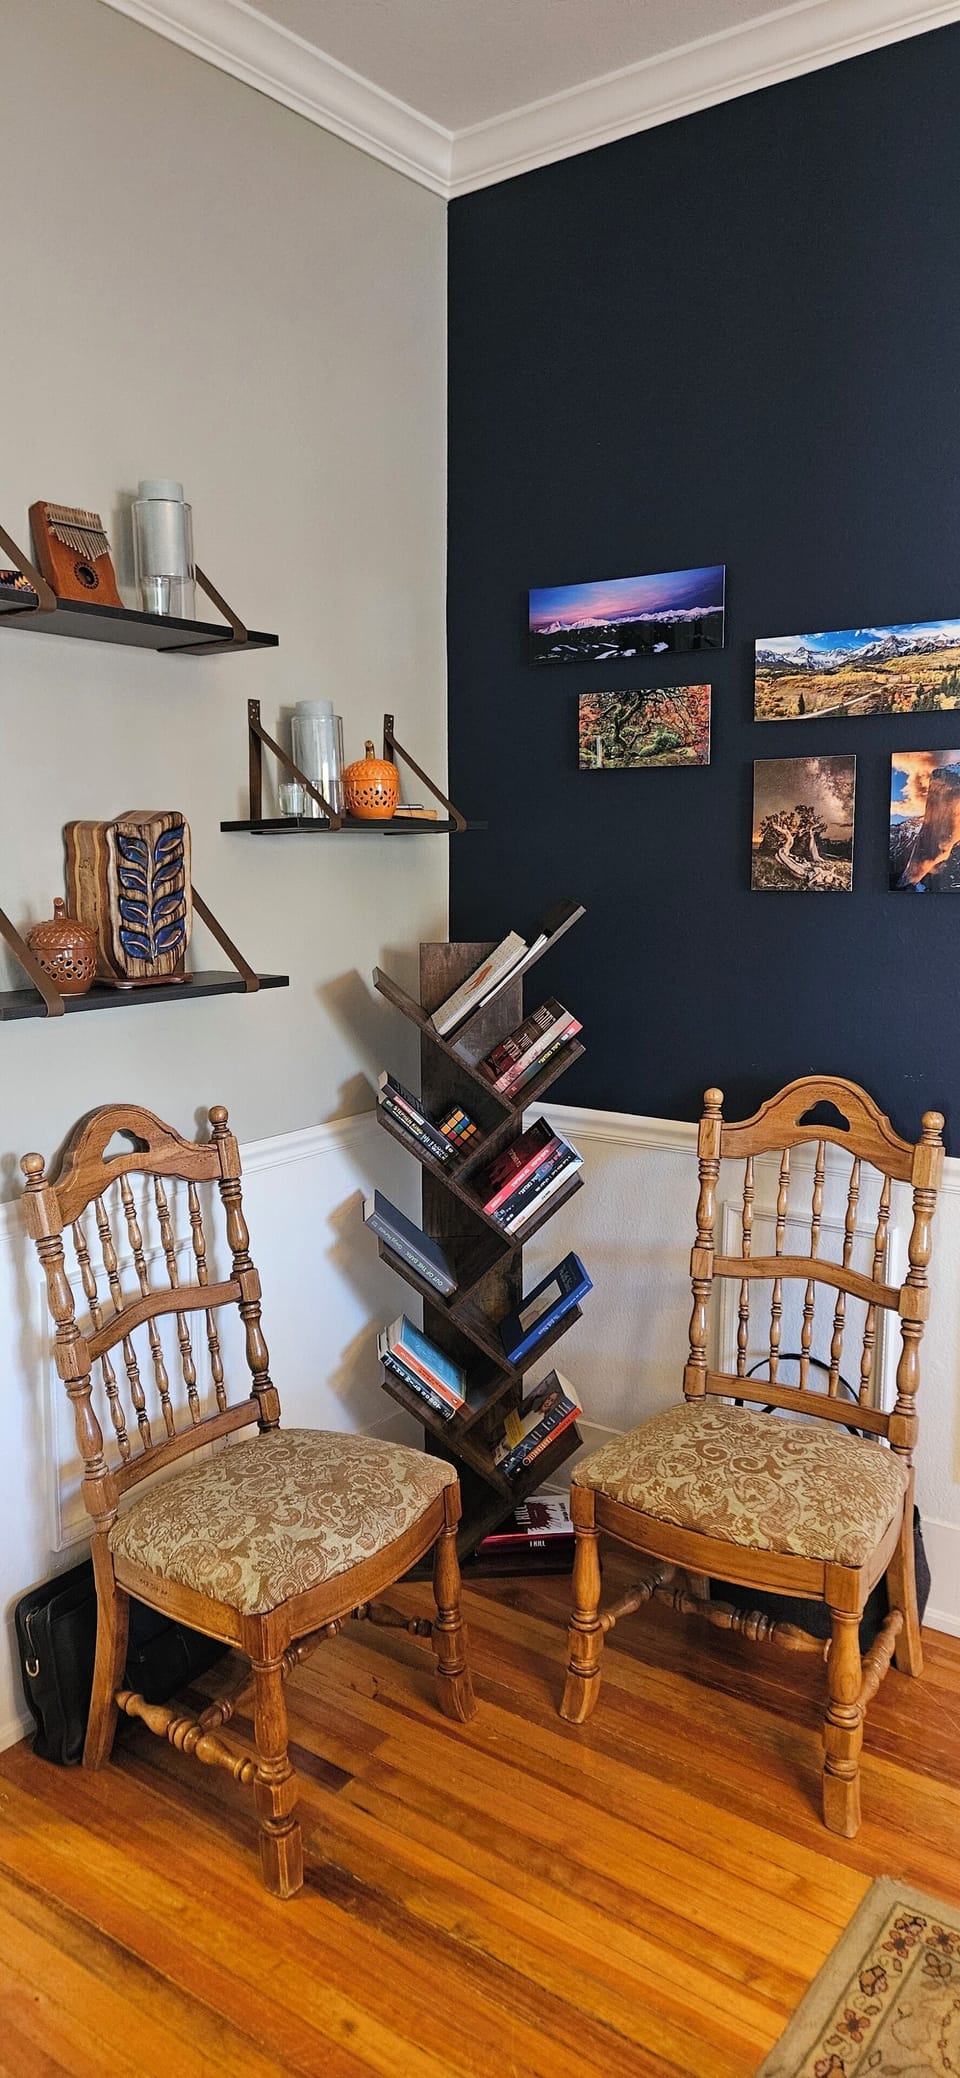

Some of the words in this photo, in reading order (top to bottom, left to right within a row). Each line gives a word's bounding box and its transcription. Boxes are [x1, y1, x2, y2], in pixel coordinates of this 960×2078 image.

[392, 1104, 413, 1125] STEPHEN
[410, 1121, 424, 1135] KING
[404, 1250, 419, 1264] DARK
[416, 1261, 427, 1271] THE
[425, 1269, 434, 1278] OF
[431, 1275, 443, 1286] OUT
